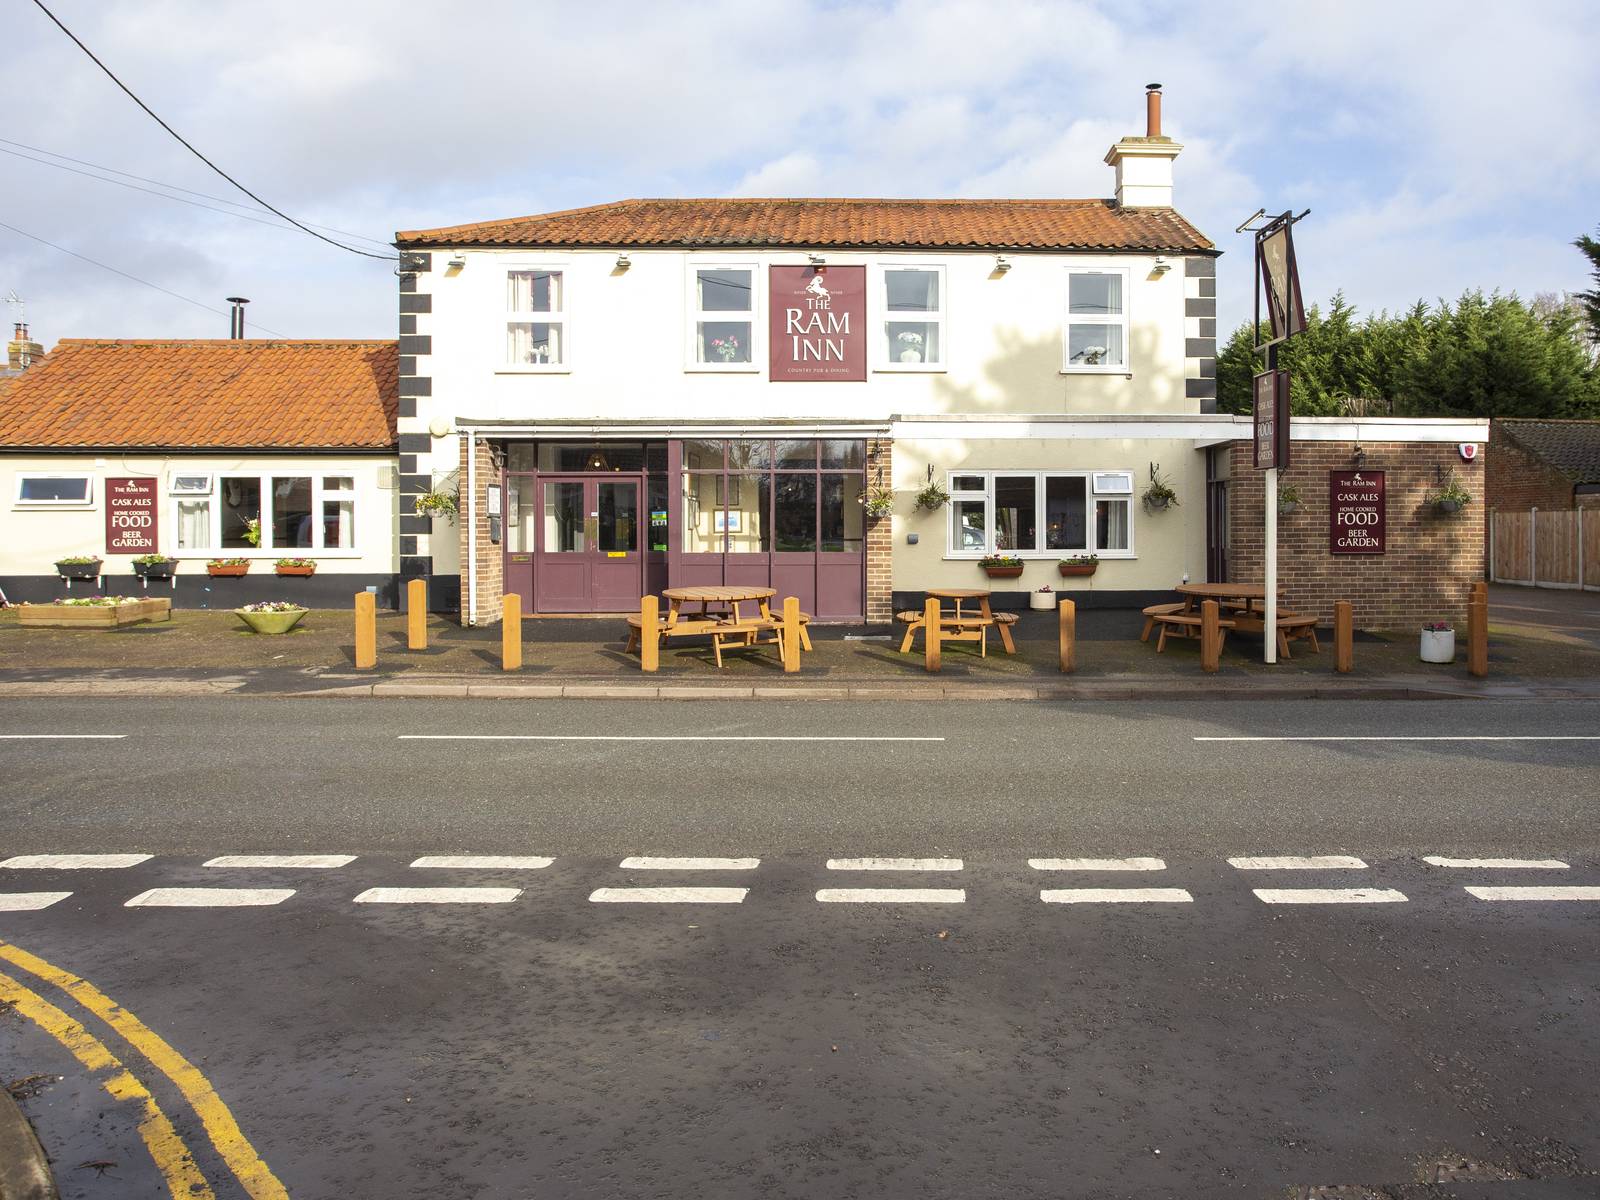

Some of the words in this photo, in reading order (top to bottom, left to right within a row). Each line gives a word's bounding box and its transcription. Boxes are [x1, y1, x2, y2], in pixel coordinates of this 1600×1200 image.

[806, 298, 831, 309] THE
[786, 308, 850, 334] RAM
[792, 335, 844, 361] INN
[1257, 421, 1274, 437] FOOD
[1337, 493, 1358, 501] CASK
[1360, 493, 1379, 501] ALES
[112, 516, 152, 528] FOOD
[1337, 512, 1379, 525] FOOD
[1348, 529, 1368, 537] BEER
[112, 539, 152, 547] GARDEN
[1337, 538, 1379, 546] GARDEN
